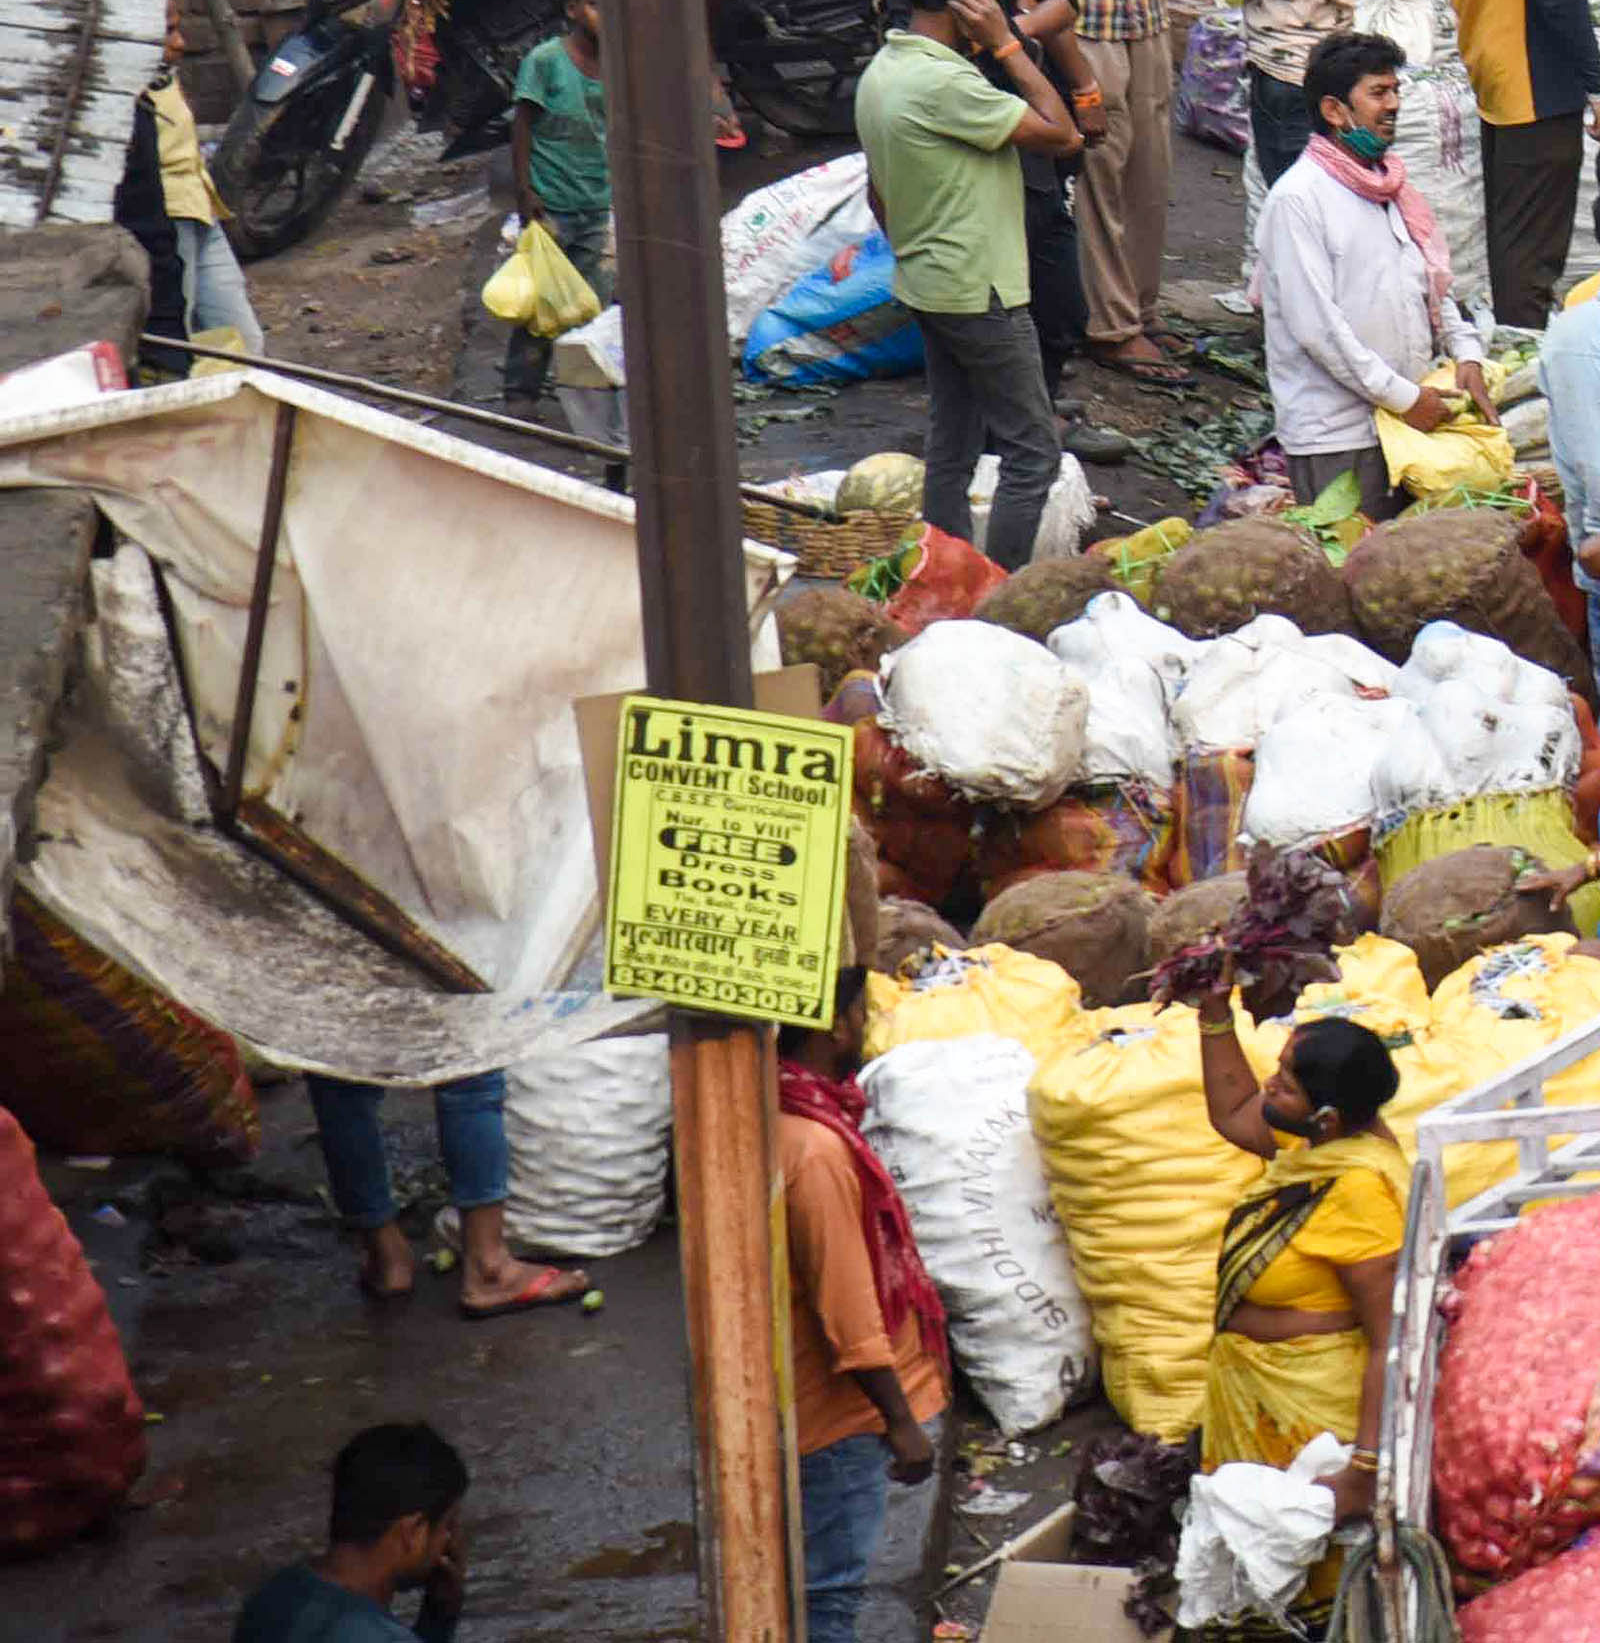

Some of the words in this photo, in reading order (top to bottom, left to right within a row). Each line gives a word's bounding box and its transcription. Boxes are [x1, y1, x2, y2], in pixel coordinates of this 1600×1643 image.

[629, 710, 838, 784] Limra
[628, 759, 732, 791] CONVENT
[721, 817, 742, 833] to
[673, 829, 783, 864] FREE
[680, 852, 777, 882] Dress
[659, 869, 799, 907] Books
[644, 904, 725, 929] EVERY
[735, 914, 799, 942] YEAR
[961, 1100, 1028, 1216] VINAYAK
[971, 1228, 1068, 1331] SIDDHI
